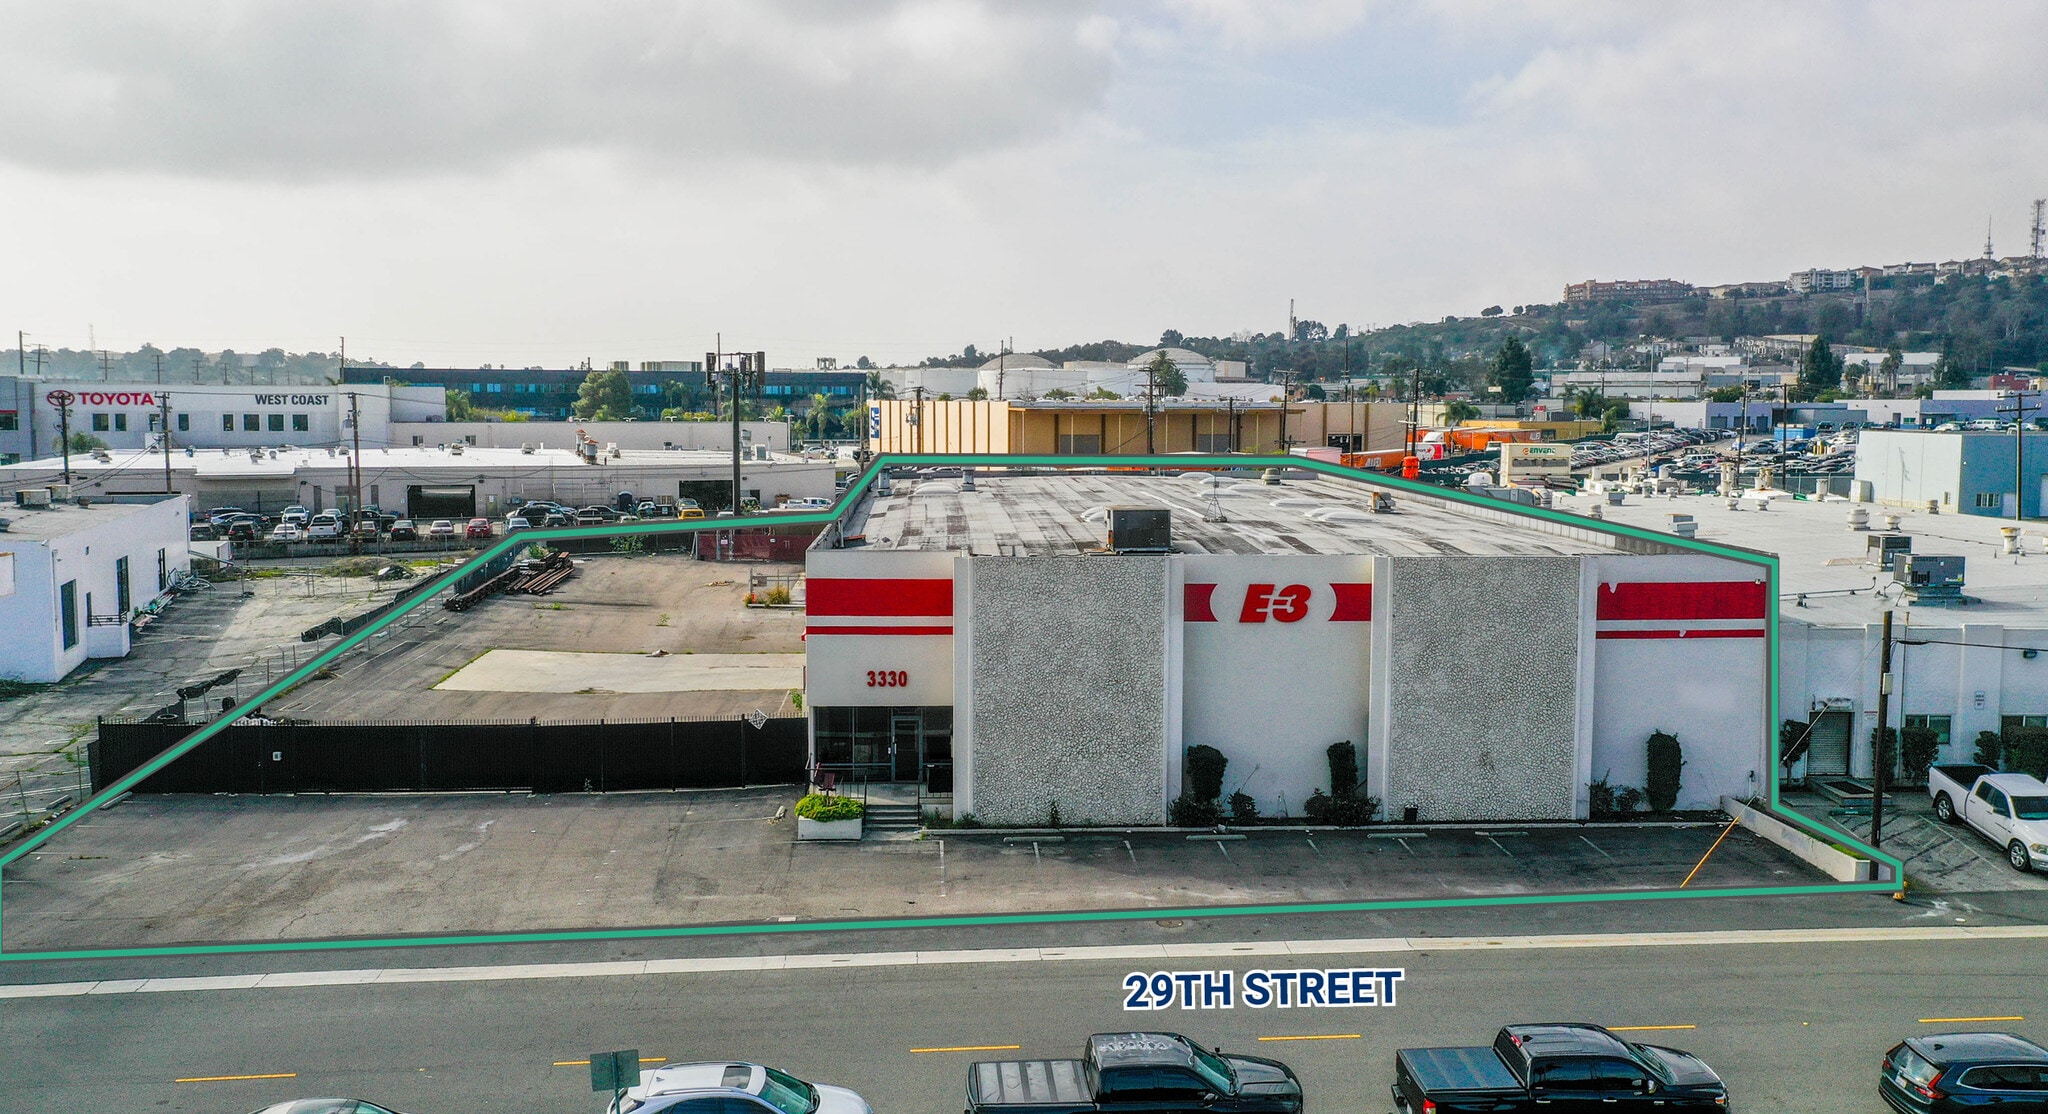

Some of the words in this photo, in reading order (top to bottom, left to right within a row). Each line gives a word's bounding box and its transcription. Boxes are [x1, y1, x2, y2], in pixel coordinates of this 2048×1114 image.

[79, 392, 155, 406] TOYOTA
[255, 394, 288, 405] WEST
[291, 394, 329, 405] COAST
[1239, 583, 1312, 623] E3
[866, 670, 908, 687] 3330
